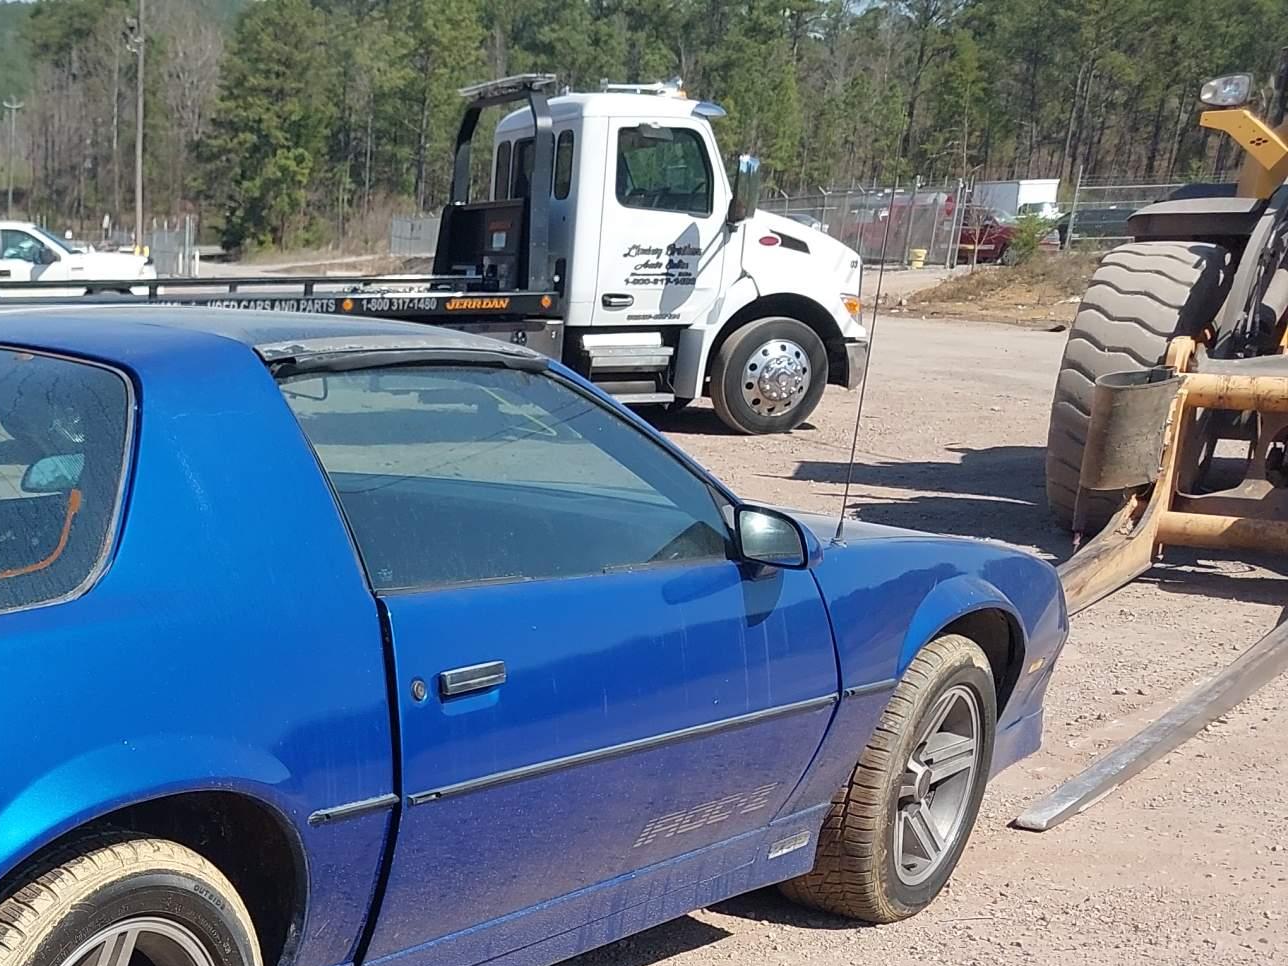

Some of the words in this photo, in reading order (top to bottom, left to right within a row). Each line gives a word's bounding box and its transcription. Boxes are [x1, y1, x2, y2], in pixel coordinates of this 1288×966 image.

[240, 301, 271, 311] CARS
[274, 301, 297, 312] AND
[300, 300, 336, 313] PARTS
[362, 299, 389, 312] 1-800
